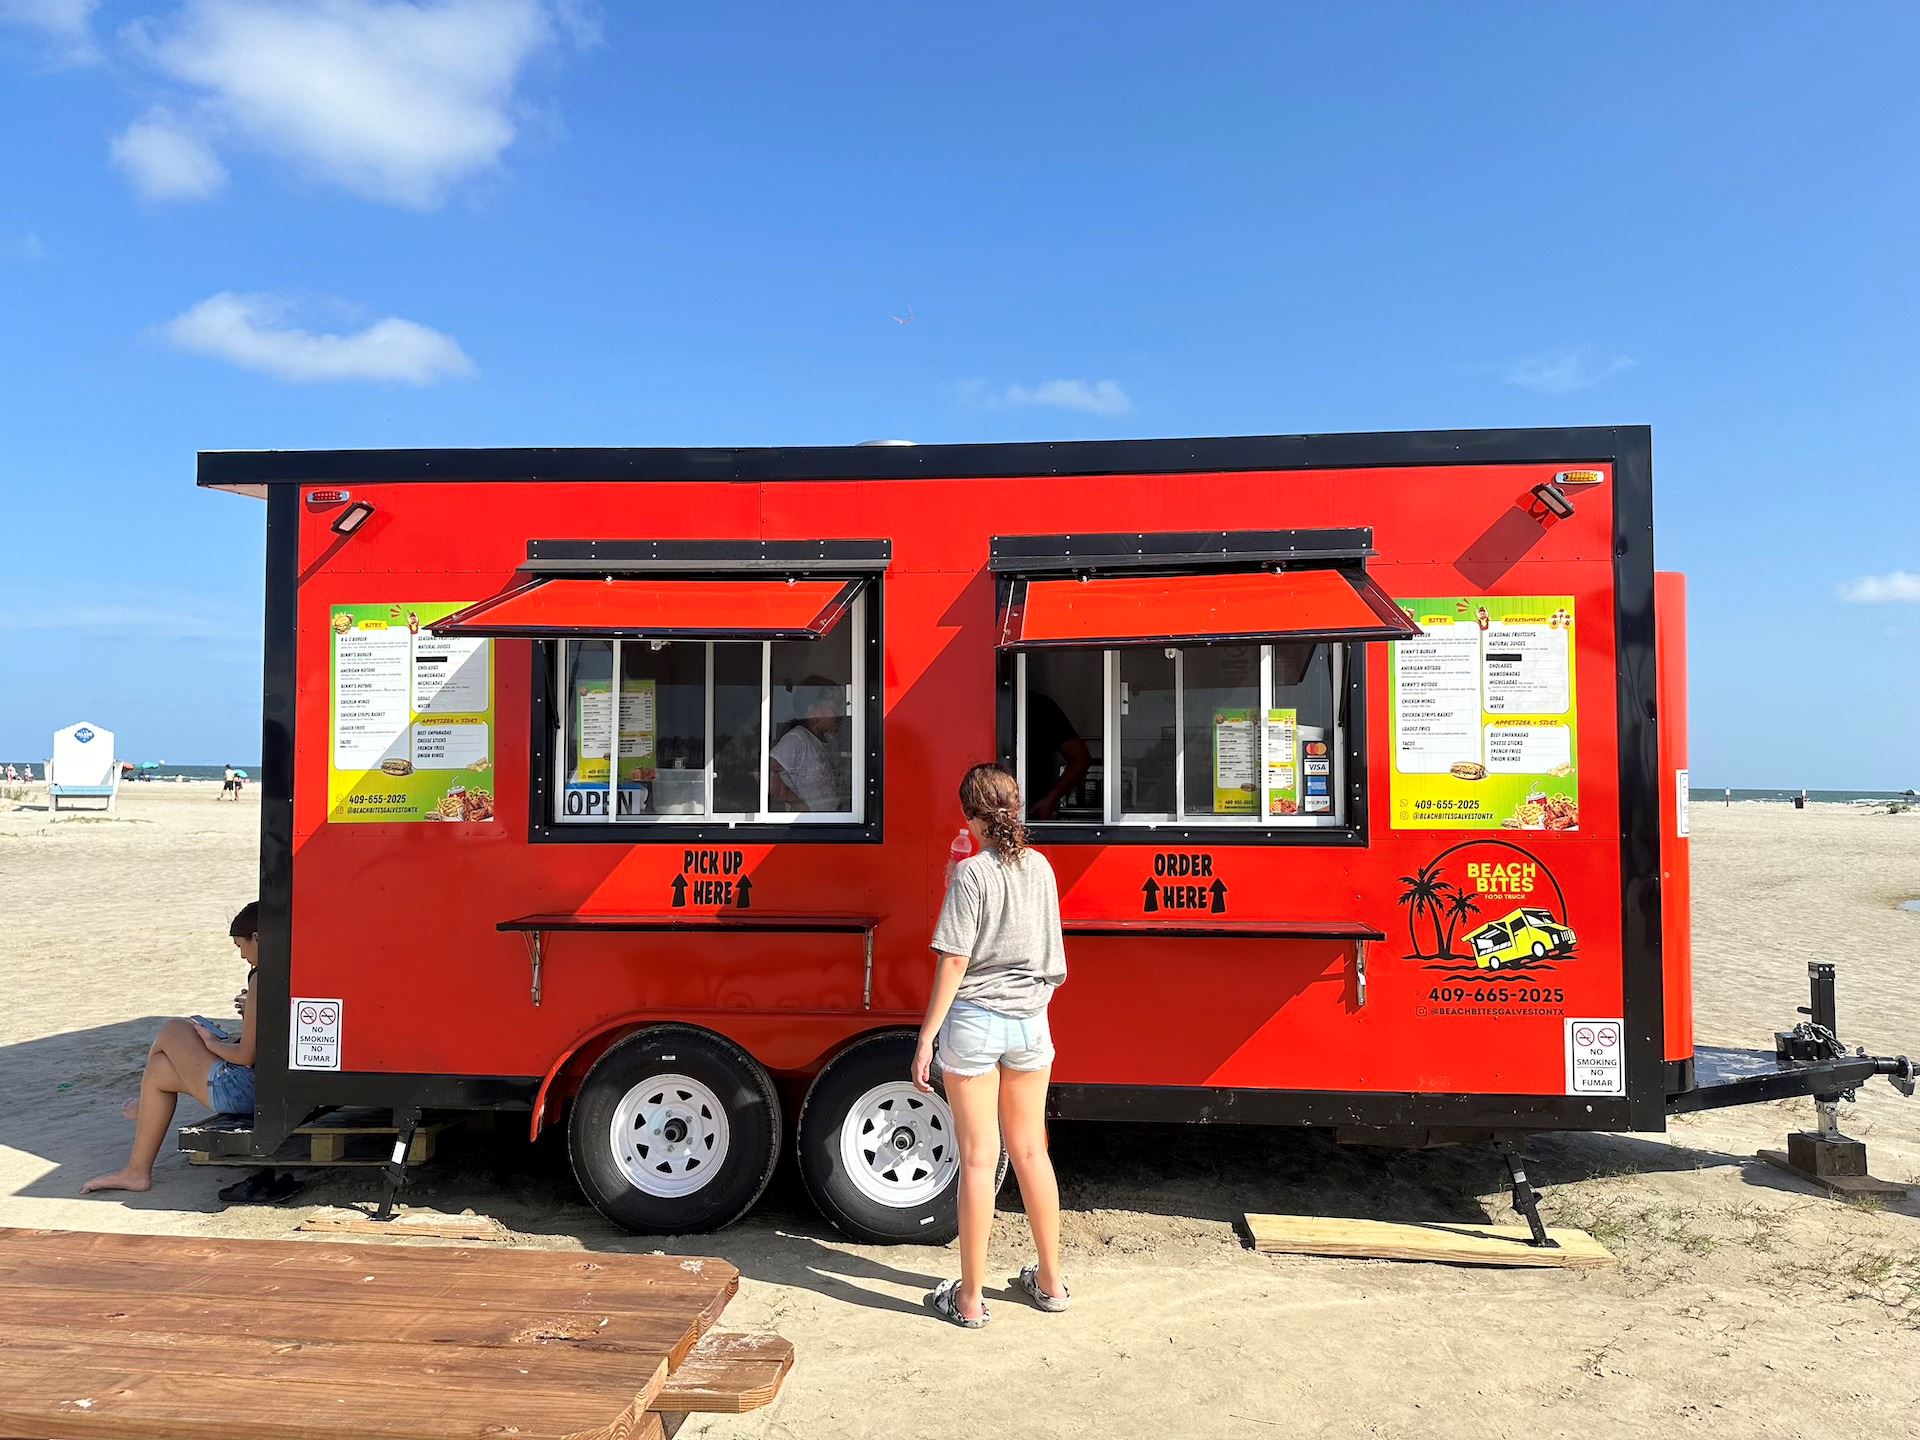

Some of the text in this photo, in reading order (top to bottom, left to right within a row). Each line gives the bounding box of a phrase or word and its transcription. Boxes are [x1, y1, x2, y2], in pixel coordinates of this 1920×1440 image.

[349, 794, 407, 804] 409-655-2025
[567, 791, 632, 815] OPEN
[1415, 800, 1480, 809] 409-655-2025
[1413, 812, 1494, 820] @BEACHBITESGALVESTONTX
[684, 850, 743, 875] PICK UP
[1154, 854, 1213, 877] ORDER
[1467, 862, 1536, 878] BEACH
[1476, 877, 1534, 892] BITES
[694, 880, 733, 905] HERE
[1163, 886, 1208, 909] HERE
[1429, 988, 1564, 1003] 409-665-2025
[1431, 1007, 1564, 1016] @BEACHBITESGALVESTONTX
